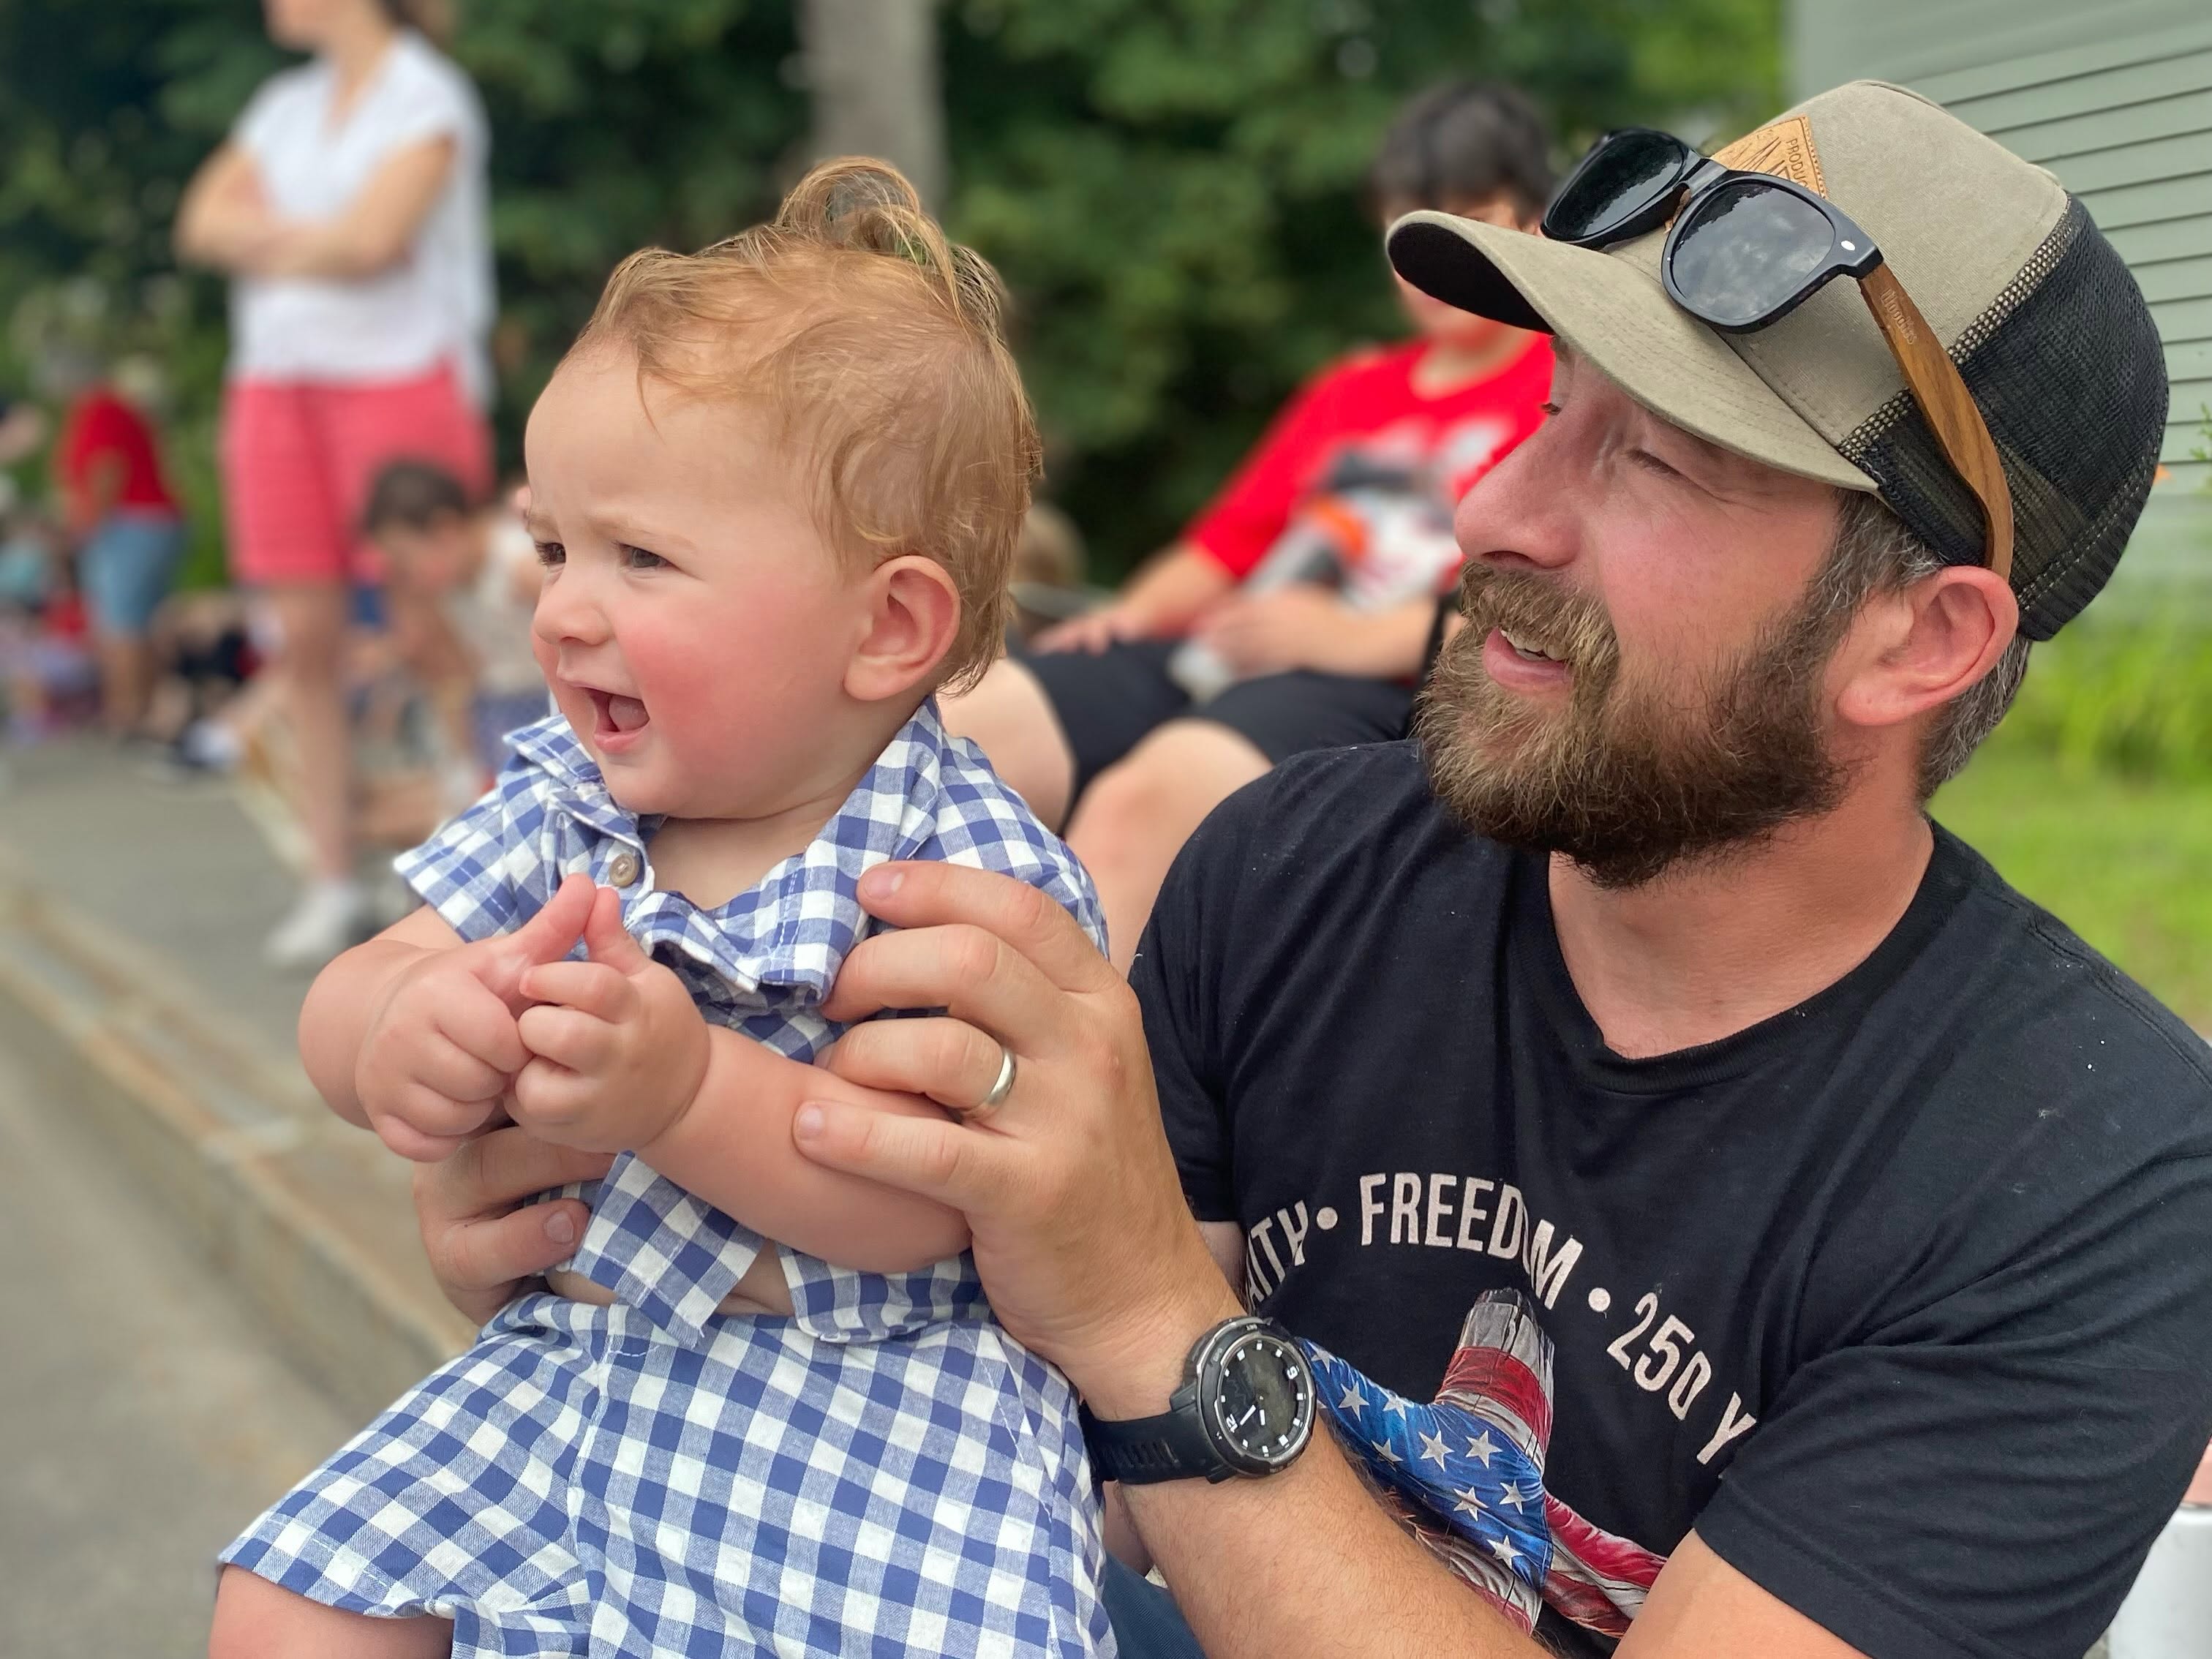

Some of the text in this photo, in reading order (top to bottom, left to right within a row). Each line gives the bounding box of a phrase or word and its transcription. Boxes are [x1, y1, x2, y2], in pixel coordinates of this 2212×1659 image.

[1360, 1173, 1583, 1309] FREEDM
[1607, 1292, 1712, 1421] 250
[1226, 1413, 1238, 1433] 12
